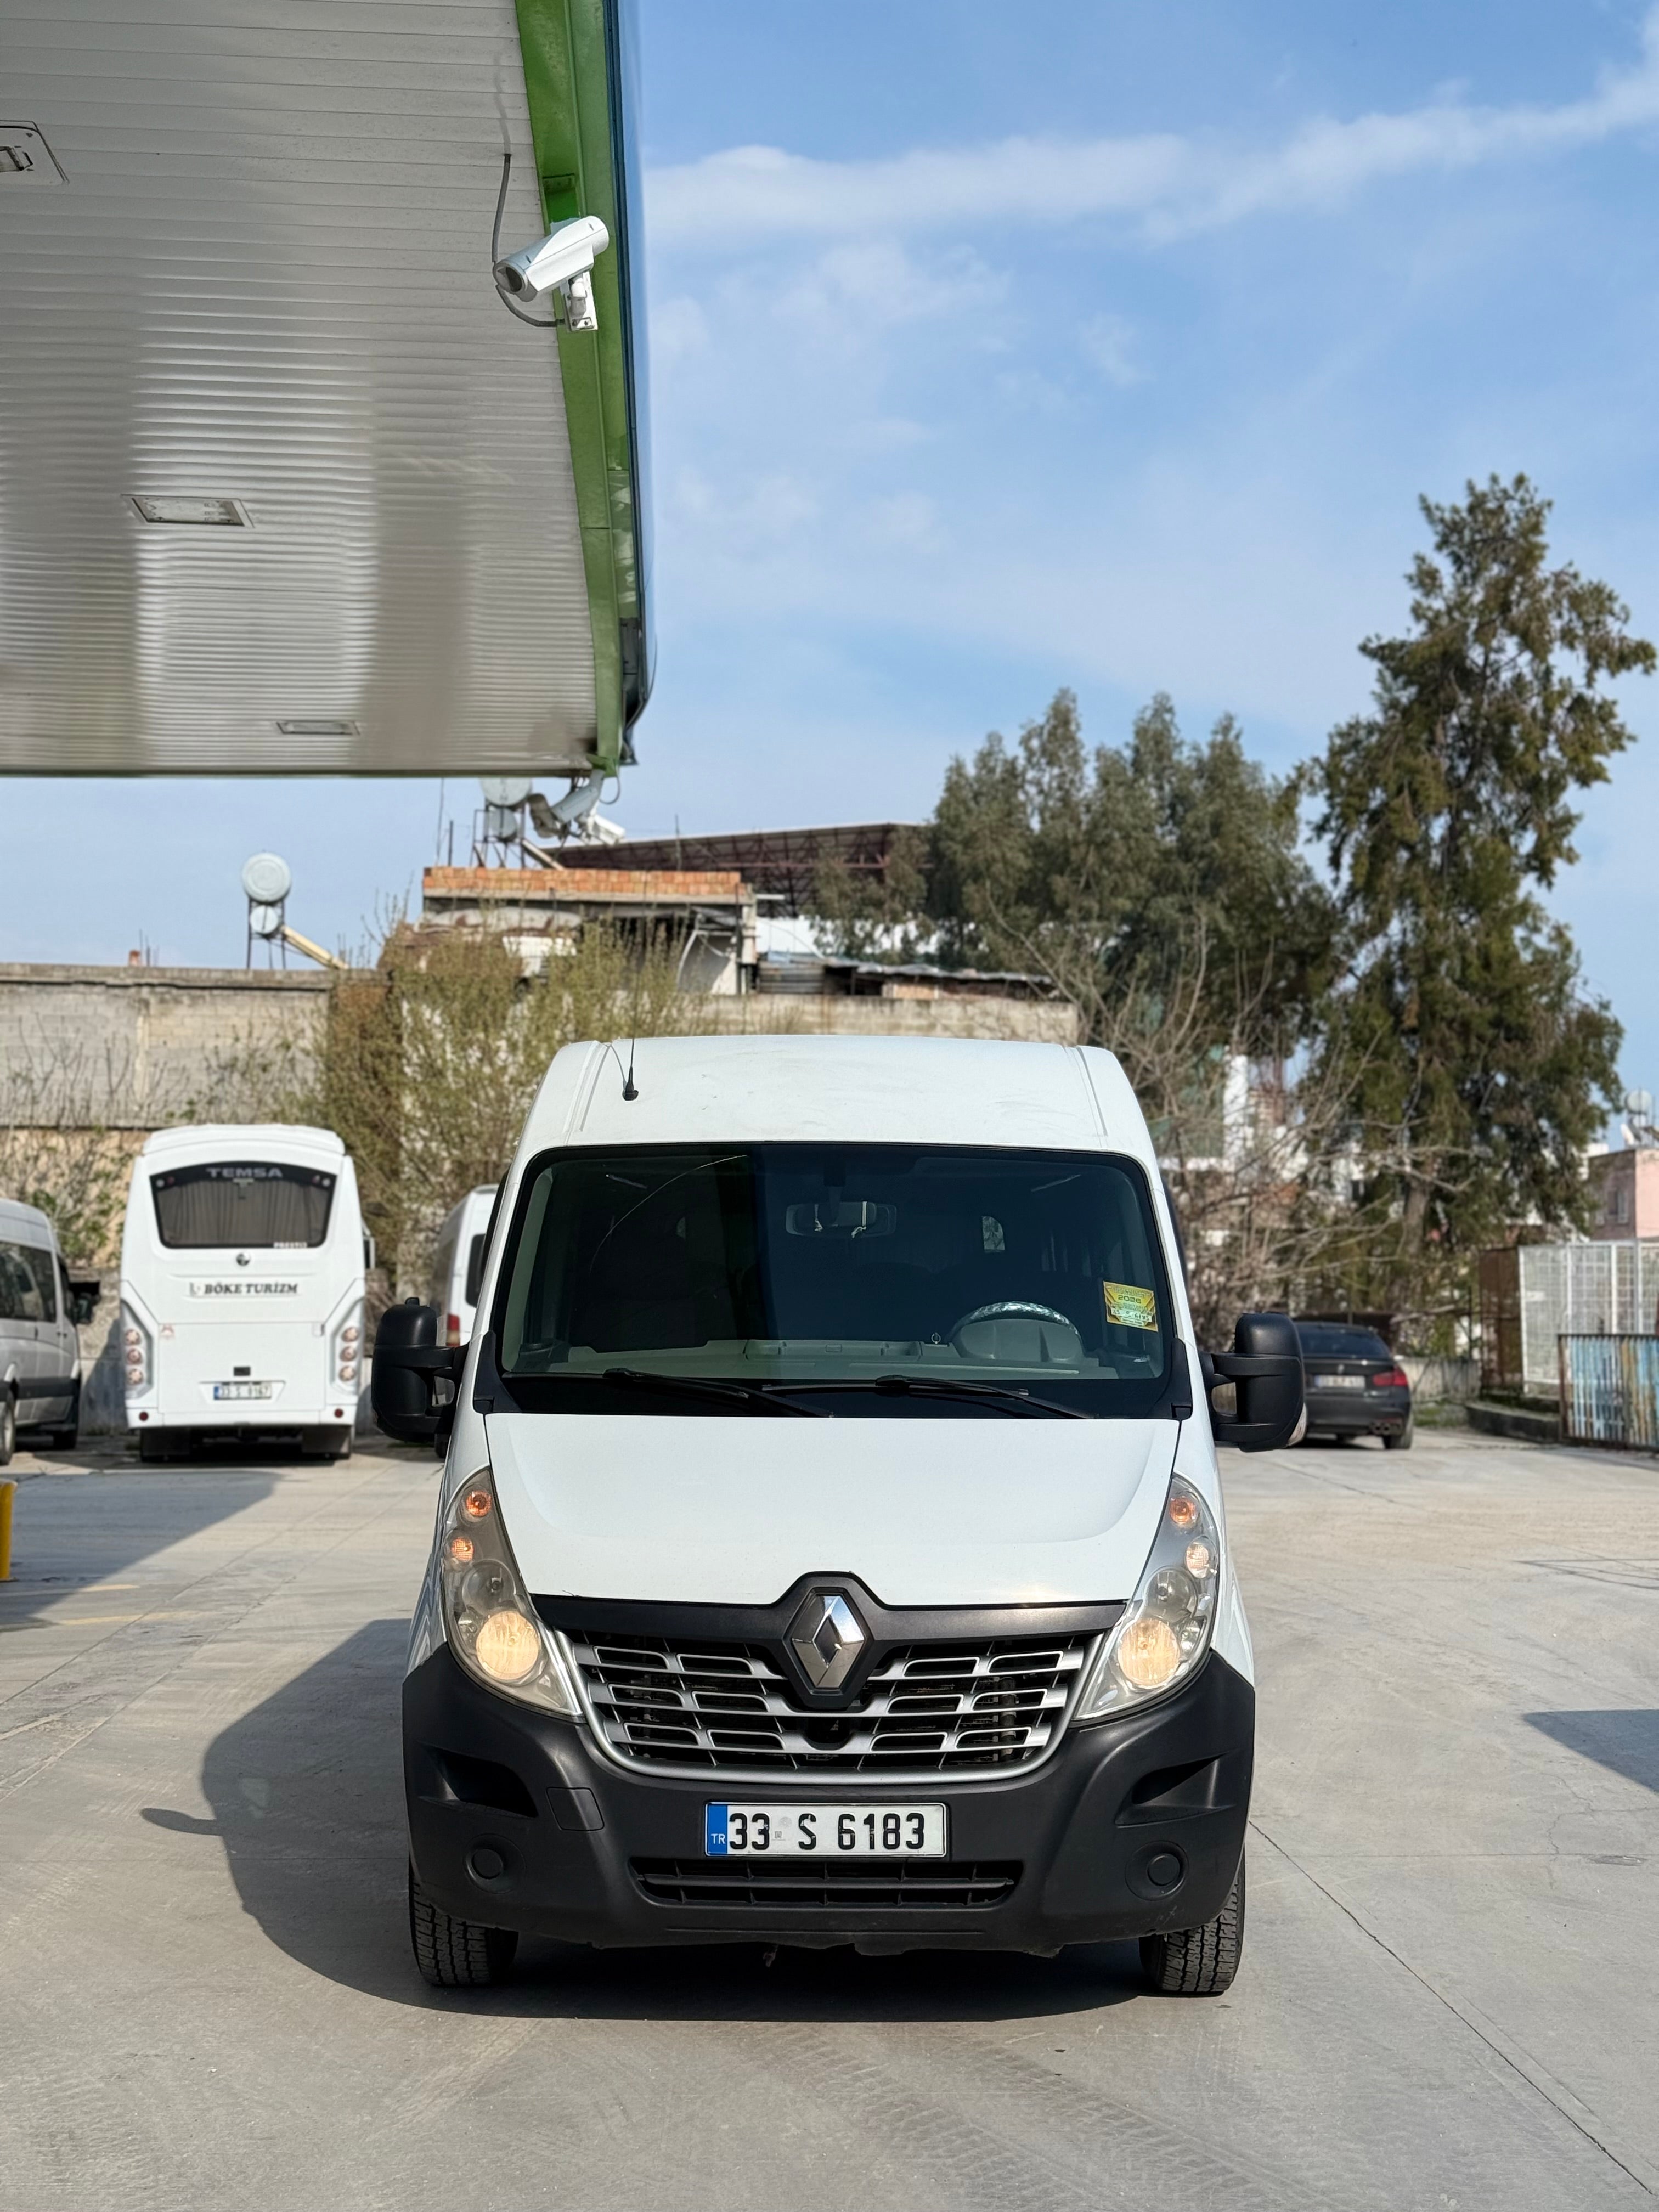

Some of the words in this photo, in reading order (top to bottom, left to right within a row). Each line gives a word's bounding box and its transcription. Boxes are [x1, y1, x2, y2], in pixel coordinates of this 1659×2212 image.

[206, 1167, 282, 1177] TEMSA
[205, 1281, 242, 1294] BÖKE
[246, 1282, 297, 1293] TURİZM
[711, 1834, 725, 1844] TR
[729, 1813, 770, 1850] 33
[798, 1813, 816, 1850] S
[838, 1813, 924, 1850] 6183
